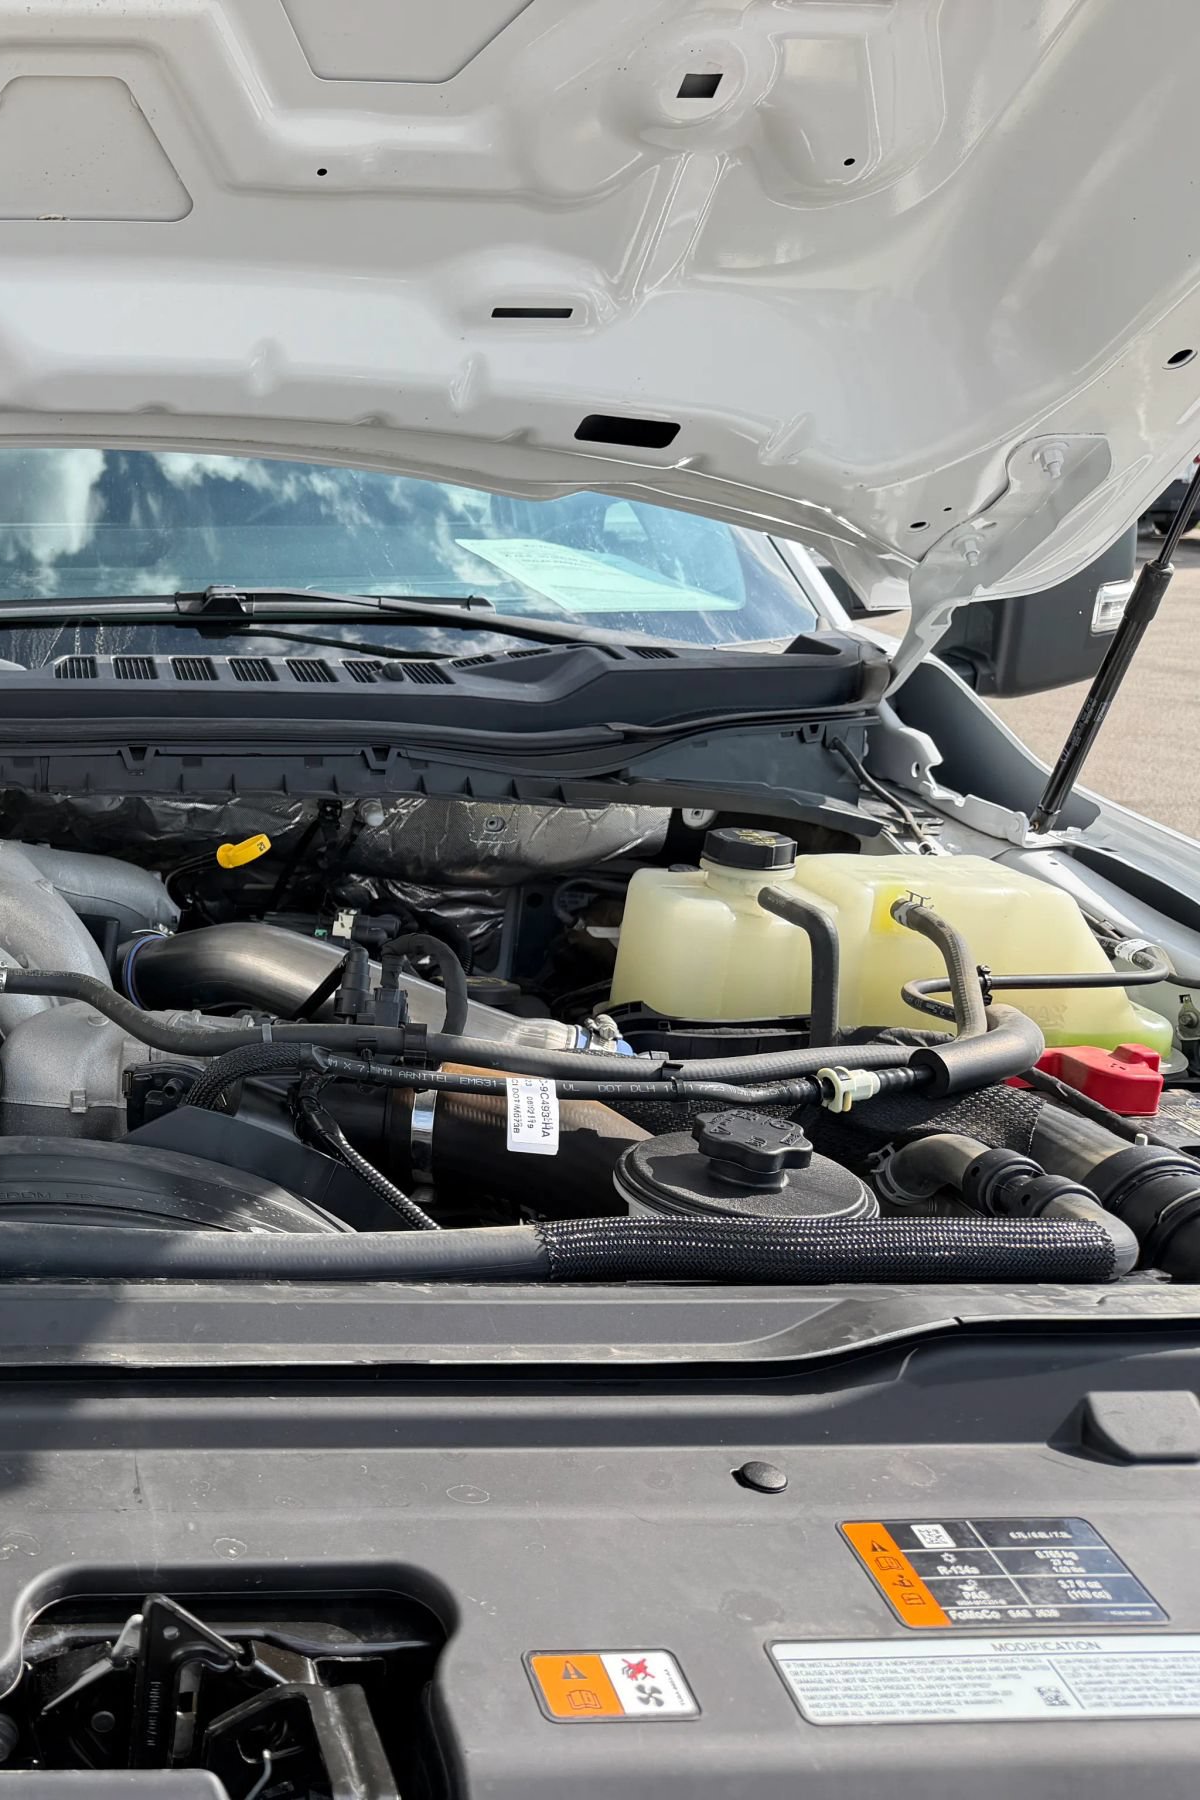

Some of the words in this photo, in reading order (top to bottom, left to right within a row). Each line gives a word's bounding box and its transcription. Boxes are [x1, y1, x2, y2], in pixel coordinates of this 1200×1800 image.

[937, 1565, 980, 1576] R-134a
[961, 1591, 992, 1601] PAG
[948, 1610, 1001, 1621] FoMoCo
[991, 1641, 1102, 1652] MODIFICATION
